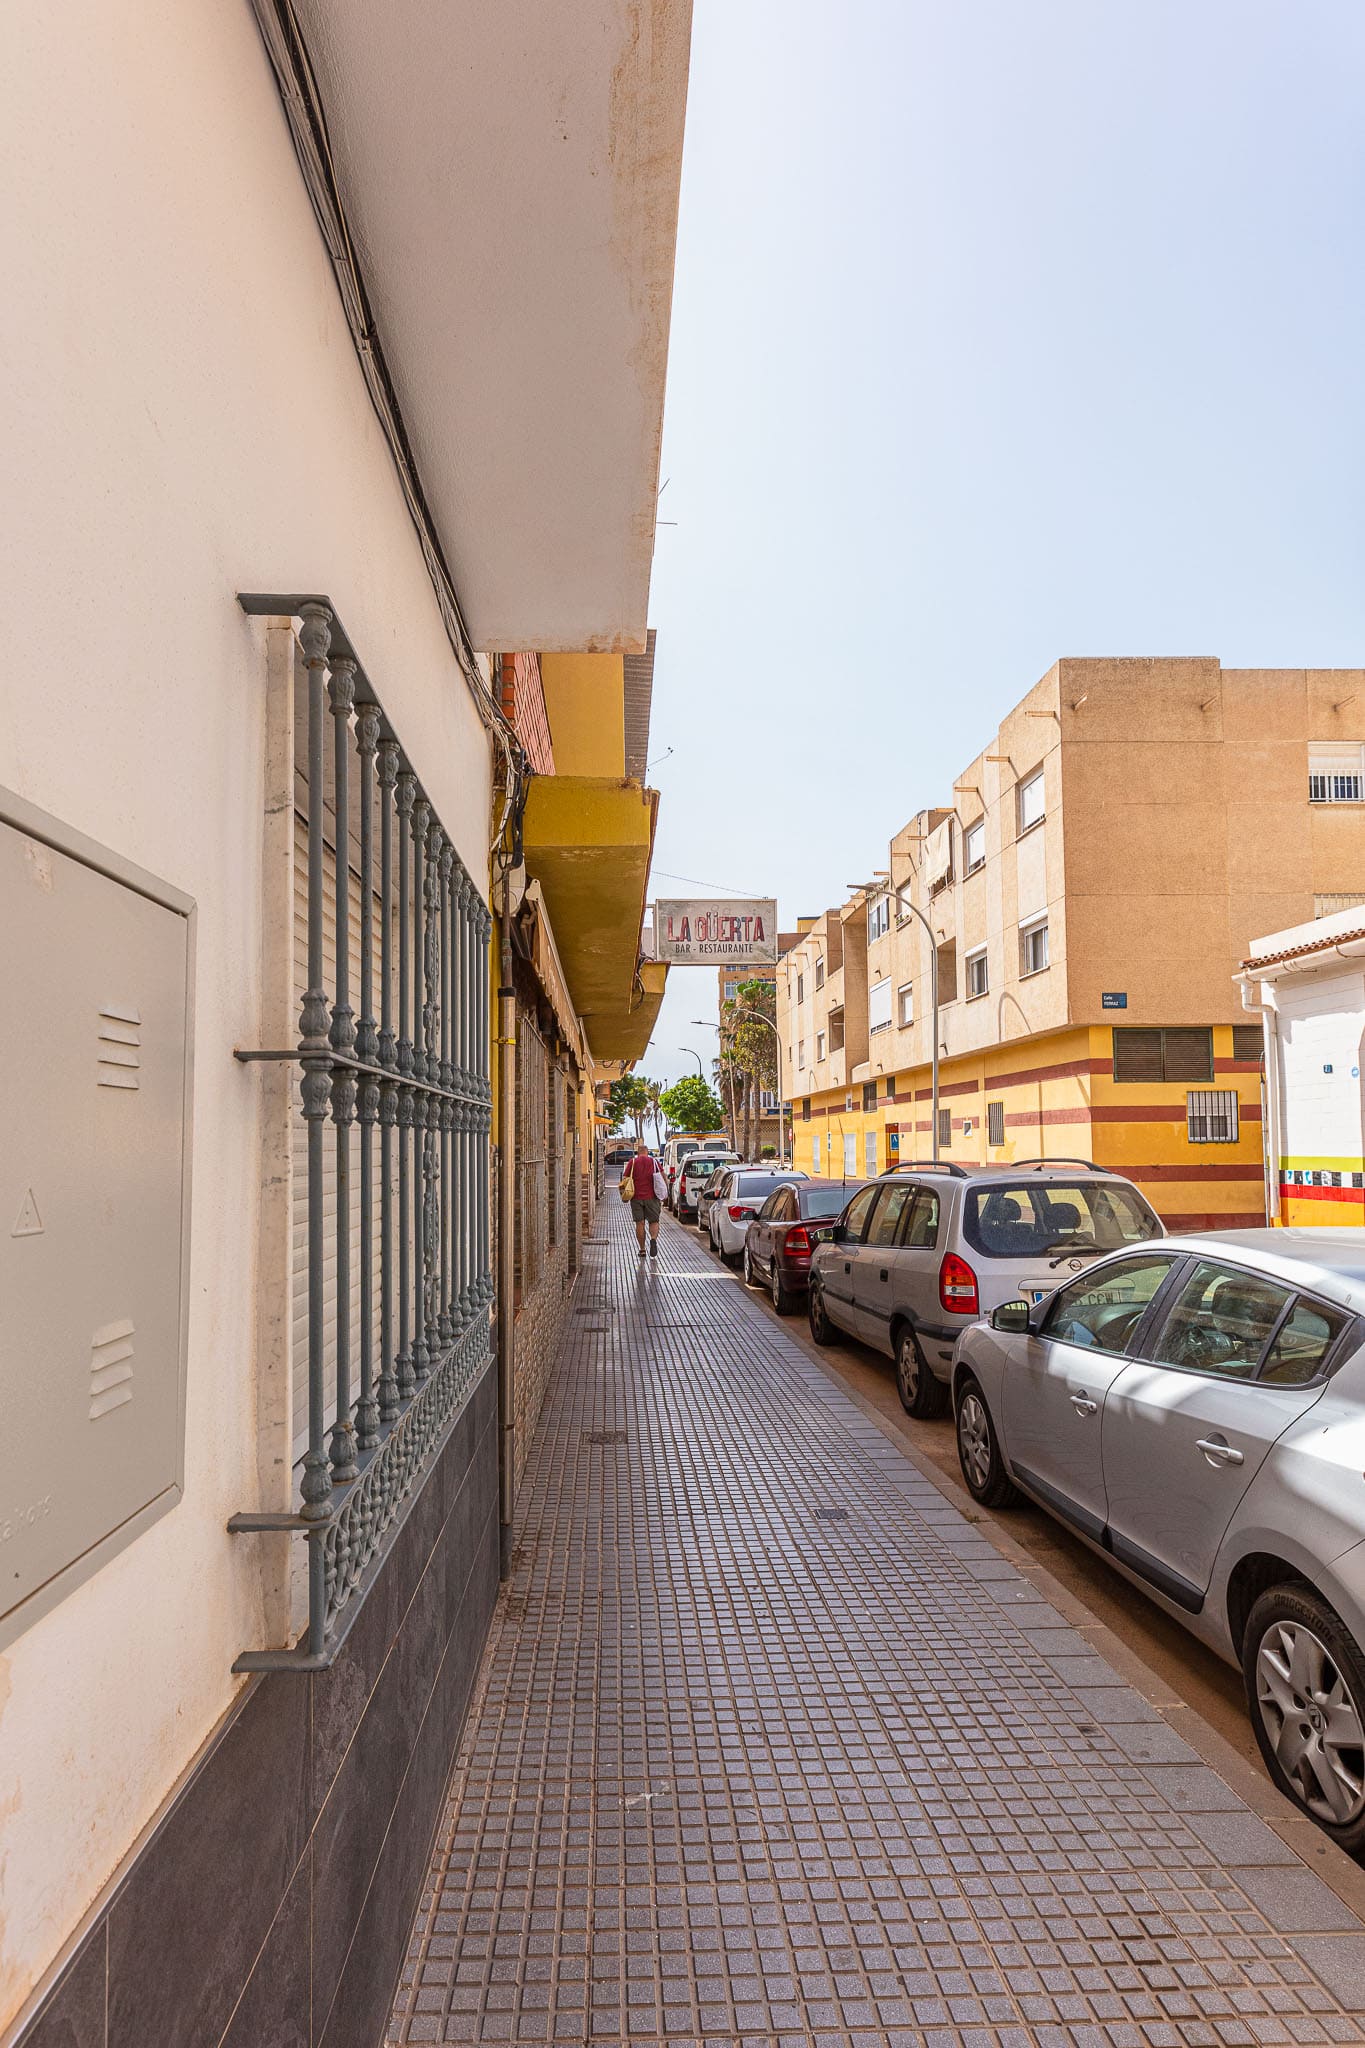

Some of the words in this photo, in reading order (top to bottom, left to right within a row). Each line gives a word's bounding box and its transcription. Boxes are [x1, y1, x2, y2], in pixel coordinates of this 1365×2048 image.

[668, 916, 691, 942] LA
[695, 912, 765, 942] GÜERTA
[675, 944, 691, 953] BAR
[699, 944, 753, 953] RESTAURANTE
